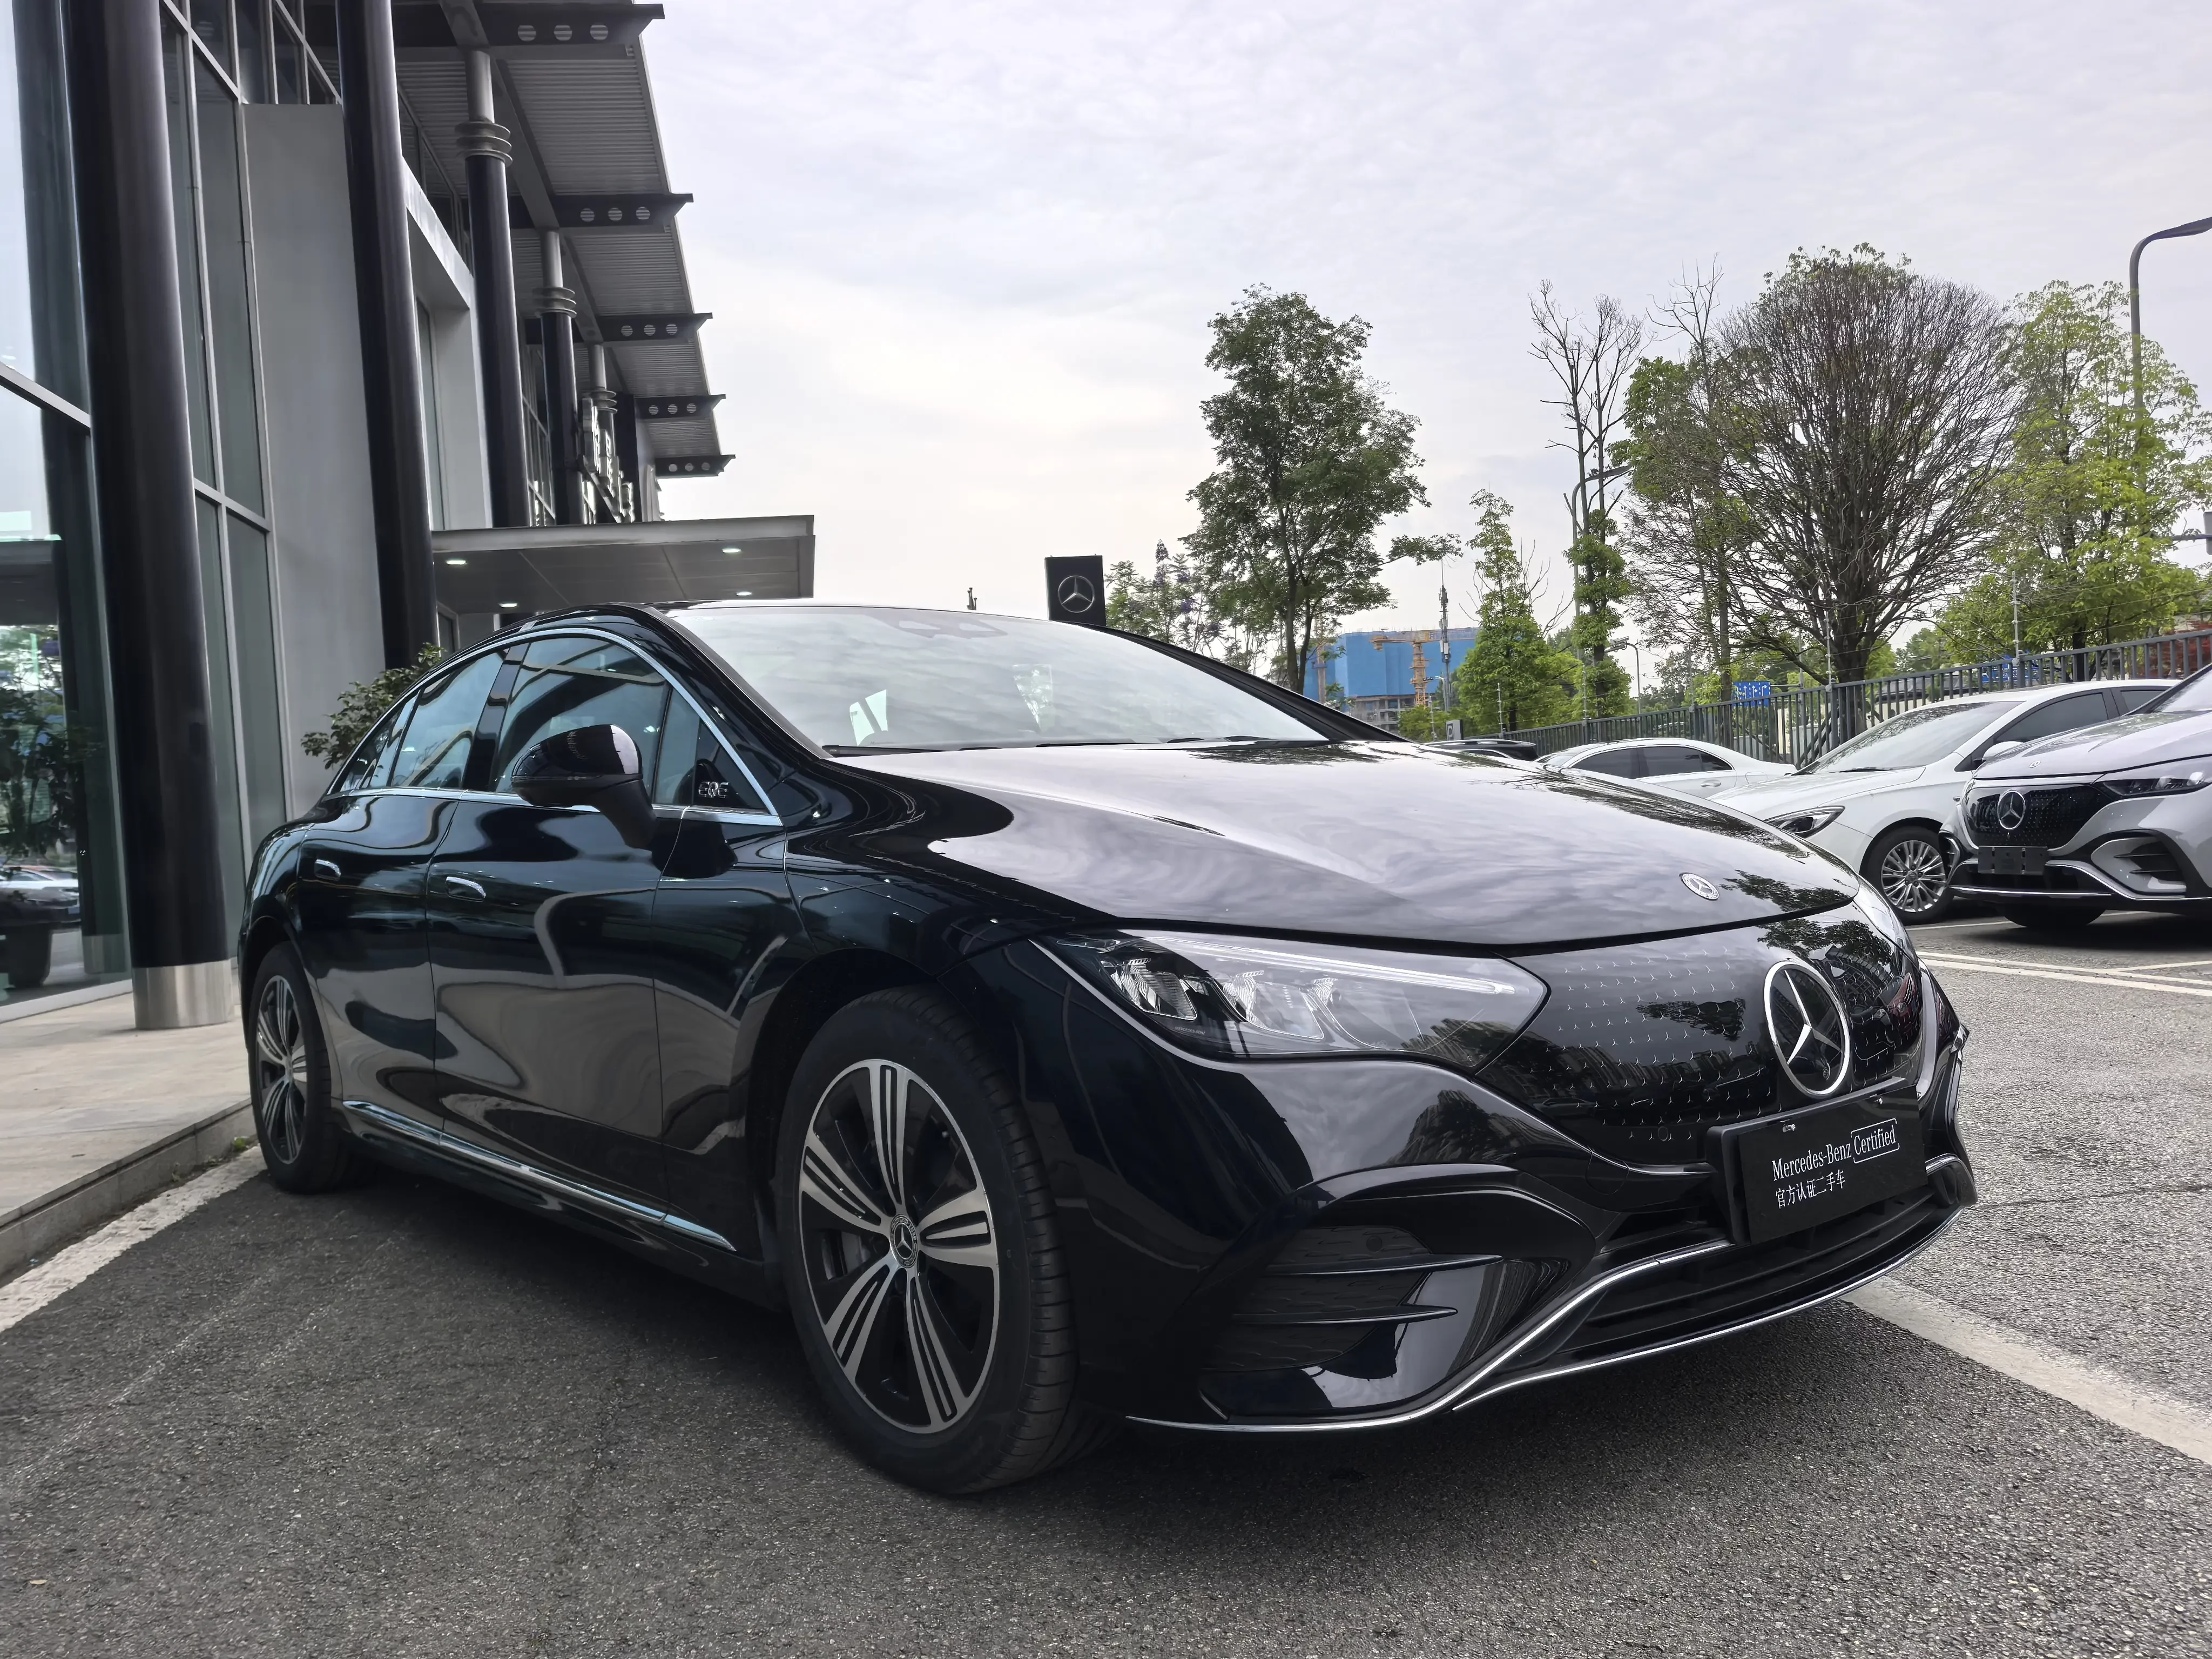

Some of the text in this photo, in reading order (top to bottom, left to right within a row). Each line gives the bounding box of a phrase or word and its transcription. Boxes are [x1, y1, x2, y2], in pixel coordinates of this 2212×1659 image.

[698, 781, 729, 798] EQE
[1771, 1125, 1896, 1182] Mercedes-Benz Certified
[1776, 1169, 1845, 1209] 官方认证二手车
